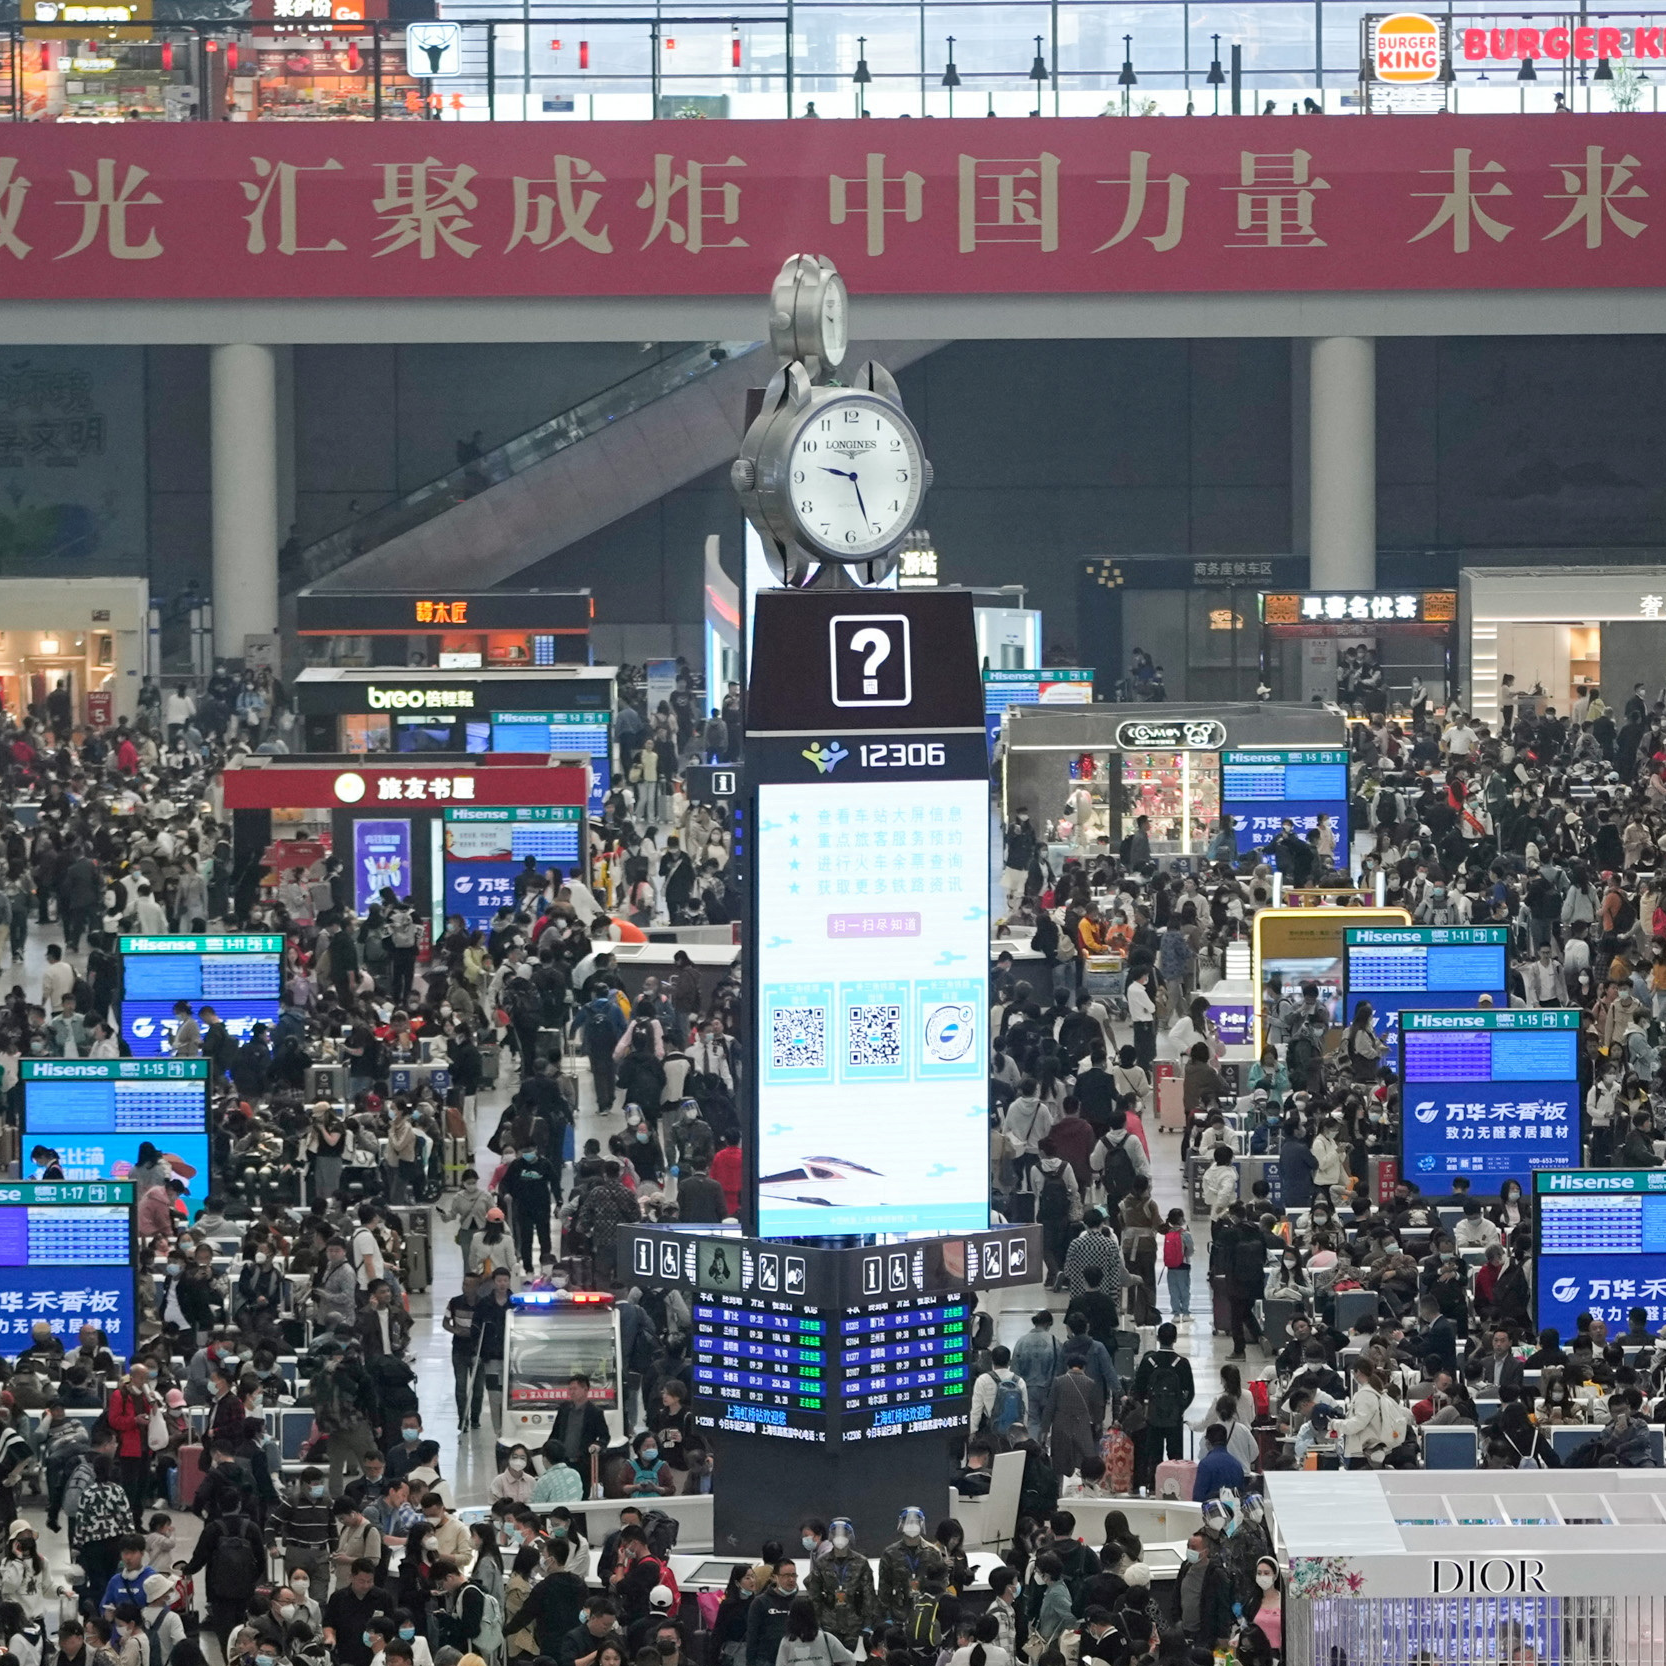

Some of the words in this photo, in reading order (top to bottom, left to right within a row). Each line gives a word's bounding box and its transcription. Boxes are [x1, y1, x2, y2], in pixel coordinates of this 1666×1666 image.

[1377, 36, 1437, 50] BURGER
[1463, 26, 1623, 61] BURGER
[1378, 51, 1437, 69] KING
[242, 153, 751, 260] 汇聚成炬
[828, 147, 1332, 258] 中国力量
[843, 410, 859, 424] 12
[821, 419, 831, 432] 11
[875, 419, 881, 431] 1
[803, 440, 817, 453] 10
[826, 440, 877, 449] LONGINES
[890, 439, 901, 452] 2
[793, 470, 805, 484] 9
[895, 469, 908, 483] 3
[801, 500, 813, 514] 8
[887, 499, 899, 512] 4
[820, 523, 831, 535] 7
[870, 522, 882, 535] 5
[845, 530, 857, 544] 6
[1193, 562, 1273, 576] 商务座候车区
[1301, 595, 1418, 620] 早春名优茶
[989, 671, 1035, 681] Hisense
[367, 686, 426, 709] breo
[498, 713, 547, 723] Hisense
[859, 743, 946, 768] 12306
[1229, 752, 1281, 763] Hisense
[377, 776, 476, 800] 旅友书屋
[452, 808, 509, 820] Hisense
[817, 806, 963, 825] 查看车站大屏信息
[817, 830, 963, 849] 重点旅客服务预约
[817, 853, 964, 872] 进行火车余票查询
[817, 876, 964, 896] 获取更多铁路资讯
[832, 917, 918, 934] 扫一扫尽知道
[1355, 930, 1422, 943] Hisense
[1451, 929, 1471, 942] 1-11
[129, 937, 197, 951] Hisense
[225, 938, 245, 950] 1-11
[1413, 1014, 1485, 1028] Hisense
[1518, 1013, 1538, 1026] 1-15
[33, 1062, 109, 1077] Hisense
[143, 1062, 164, 1076] 1-15
[1445, 1101, 1568, 1122] 万华禾香板
[1445, 1125, 1569, 1140] 致力无醛家居建材
[1550, 1173, 1635, 1191] Hisense
[60, 1186, 84, 1201] 1-17
[1430, 1558, 1548, 1594] DIOR
